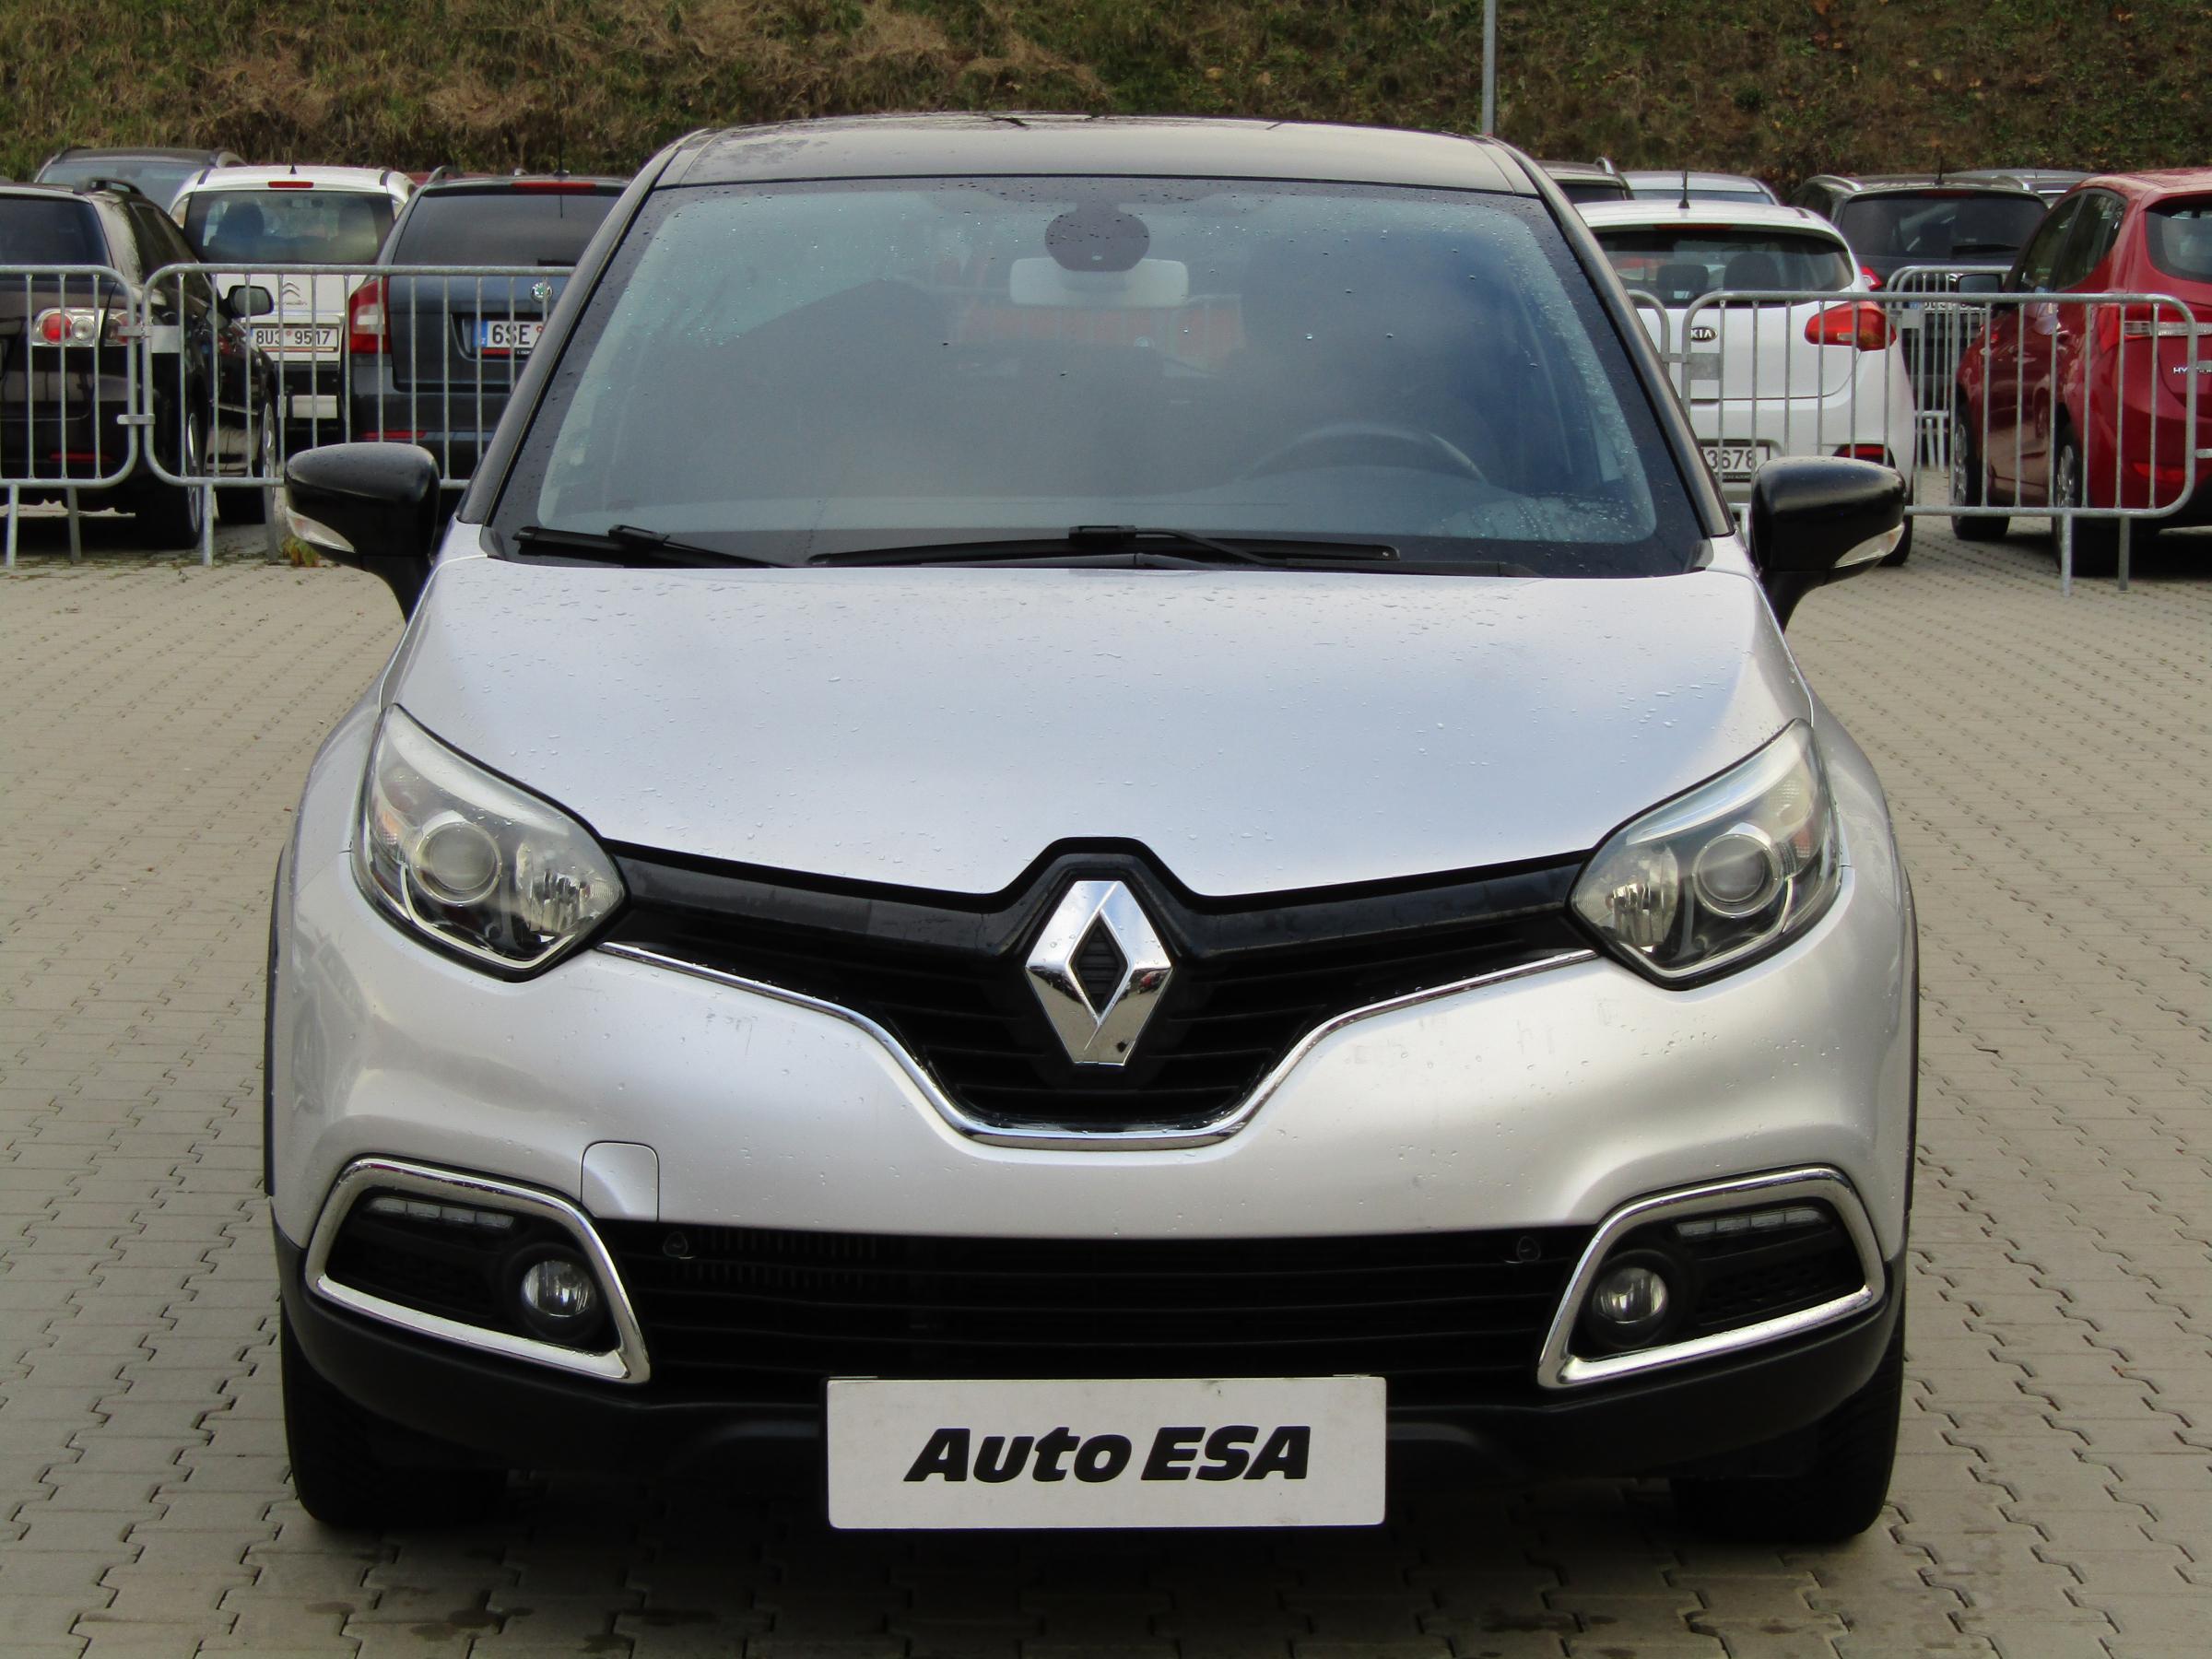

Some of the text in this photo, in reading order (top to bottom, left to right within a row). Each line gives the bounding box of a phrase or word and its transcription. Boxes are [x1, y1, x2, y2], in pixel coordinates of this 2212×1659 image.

[294, 330, 331, 346] 9517
[492, 324, 531, 346] 6SE
[1690, 329, 1712, 339] KIA
[903, 1425, 1311, 1483] Auto ESA
